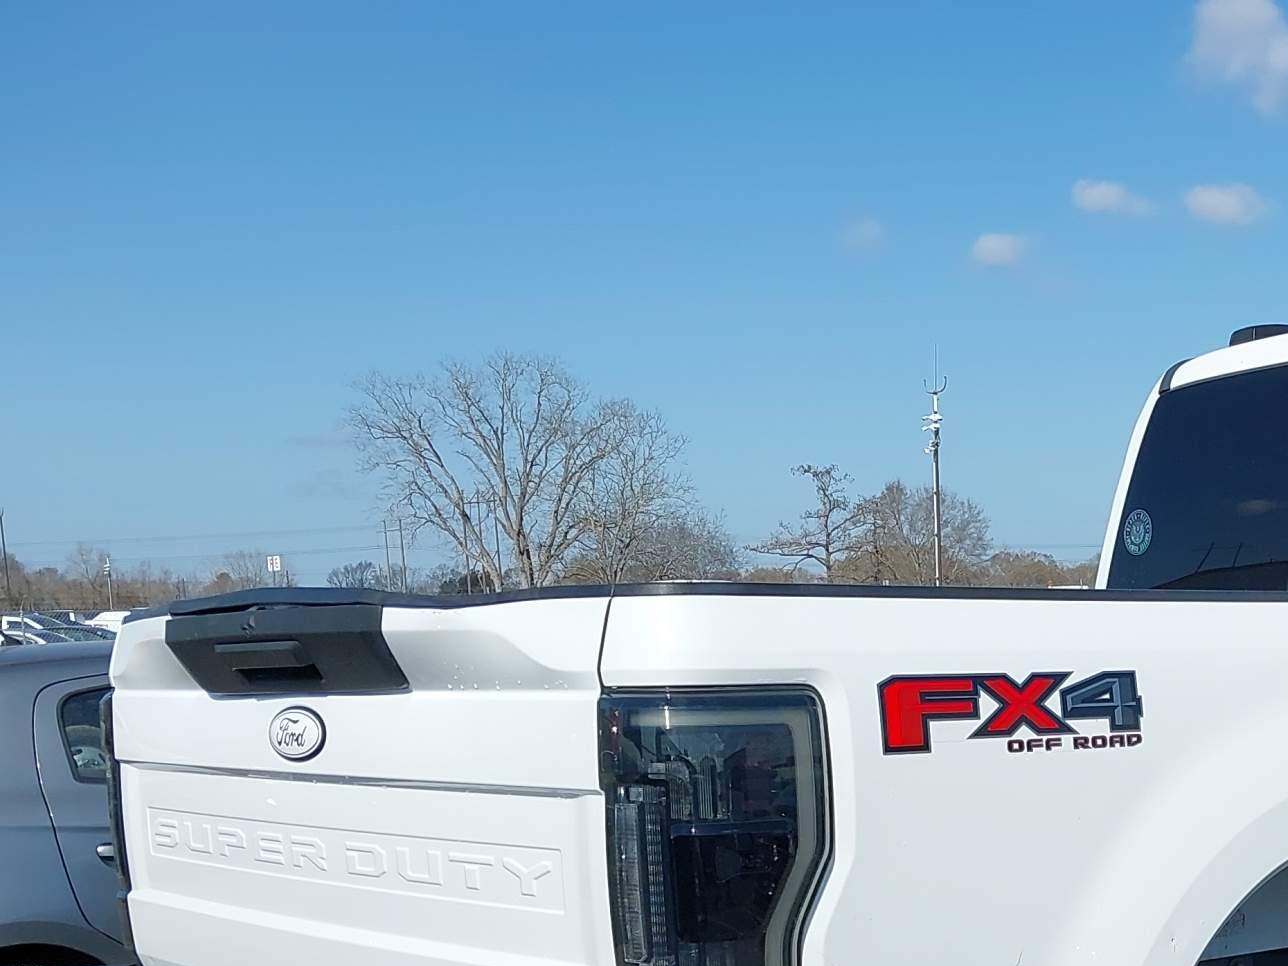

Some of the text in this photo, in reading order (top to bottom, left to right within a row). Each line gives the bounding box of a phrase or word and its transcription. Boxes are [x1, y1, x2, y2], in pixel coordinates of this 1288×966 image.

[276, 717, 308, 748] Ford
[877, 670, 1144, 755] FX4
[1006, 733, 1144, 754] OFF ROAD
[153, 818, 554, 898] SUPER DUTY
